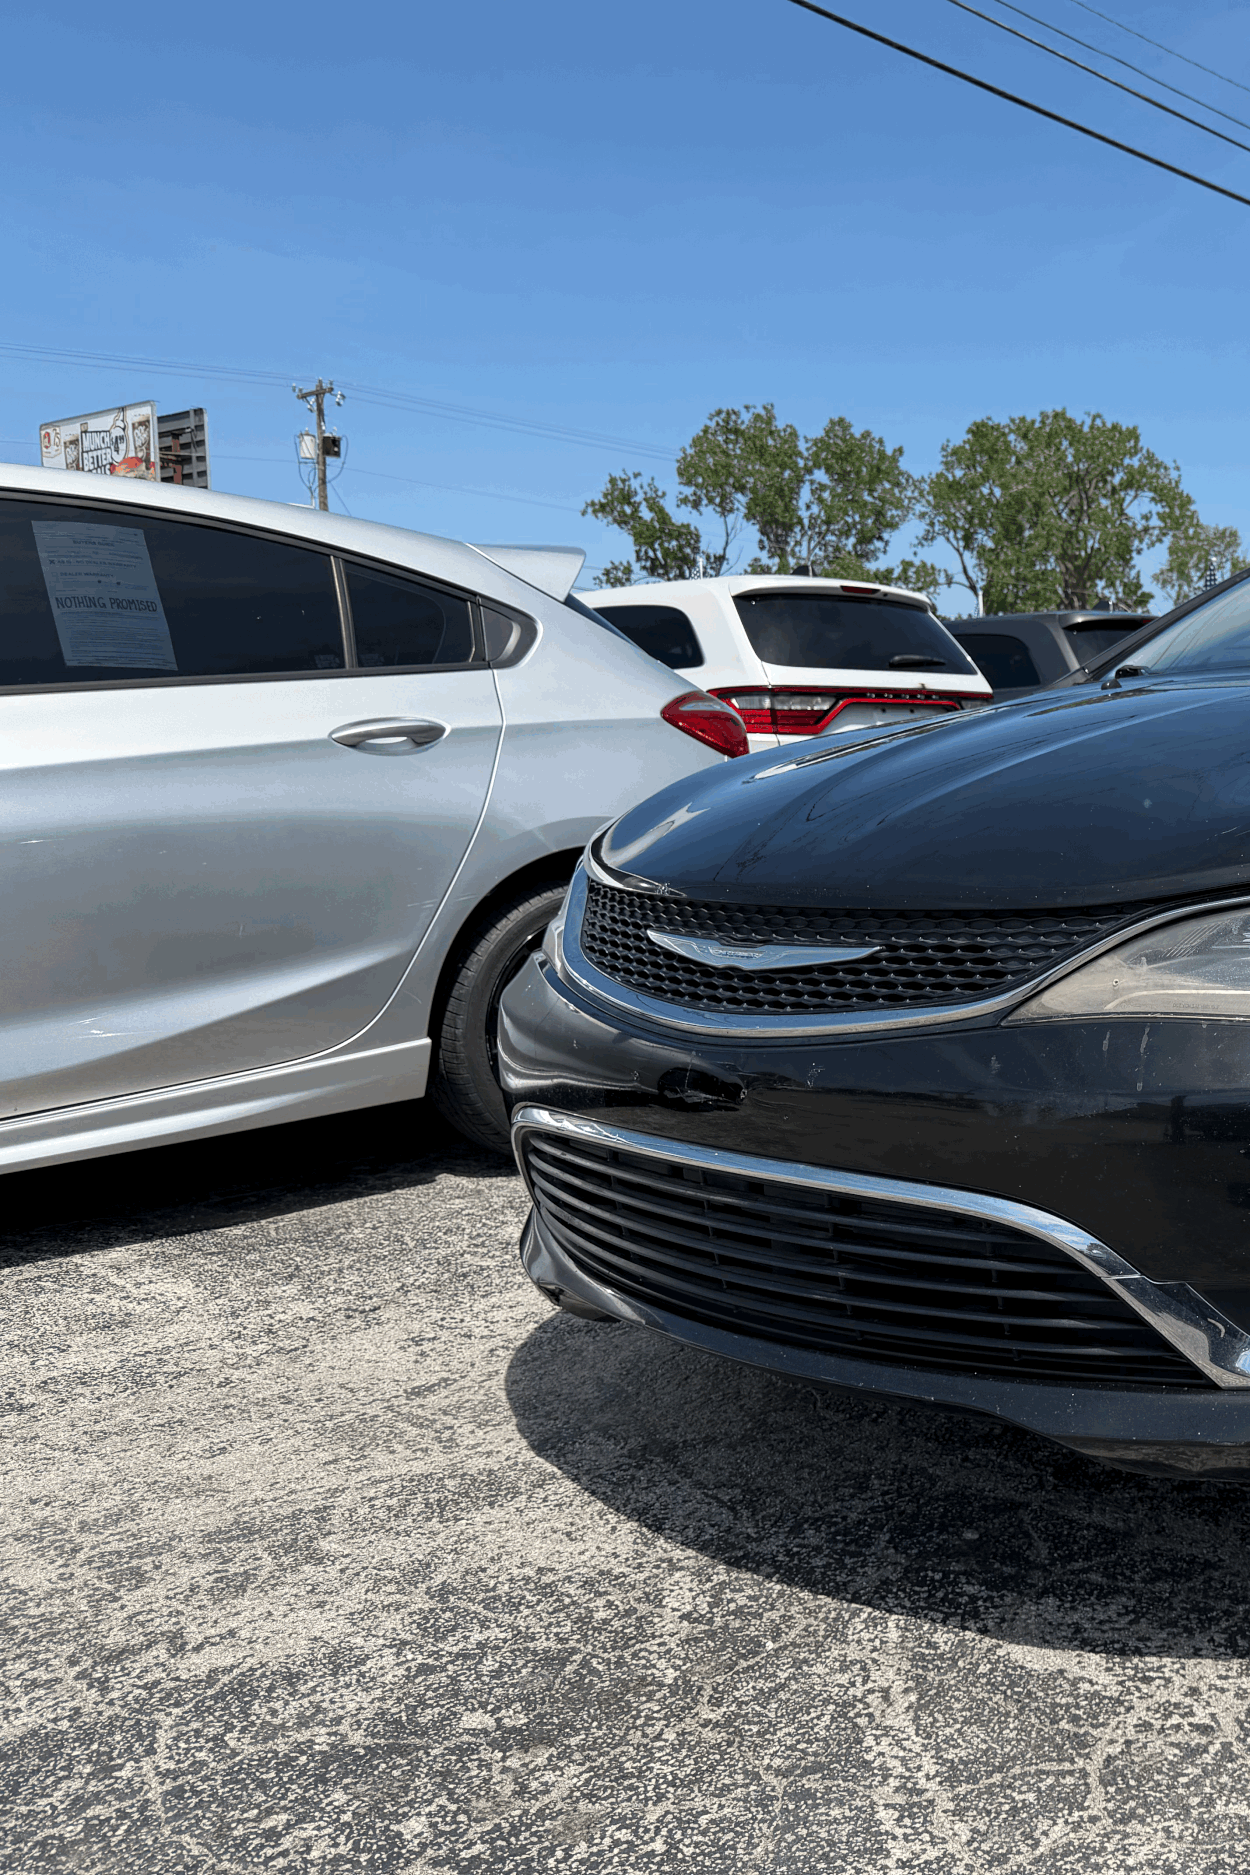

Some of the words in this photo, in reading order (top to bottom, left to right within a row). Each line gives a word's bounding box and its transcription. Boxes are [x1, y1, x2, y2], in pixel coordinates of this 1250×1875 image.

[82, 431, 110, 452] MUNCH
[83, 448, 113, 472] BETTER
[55, 595, 107, 610] NOTHING
[109, 597, 158, 612] PROMISED
